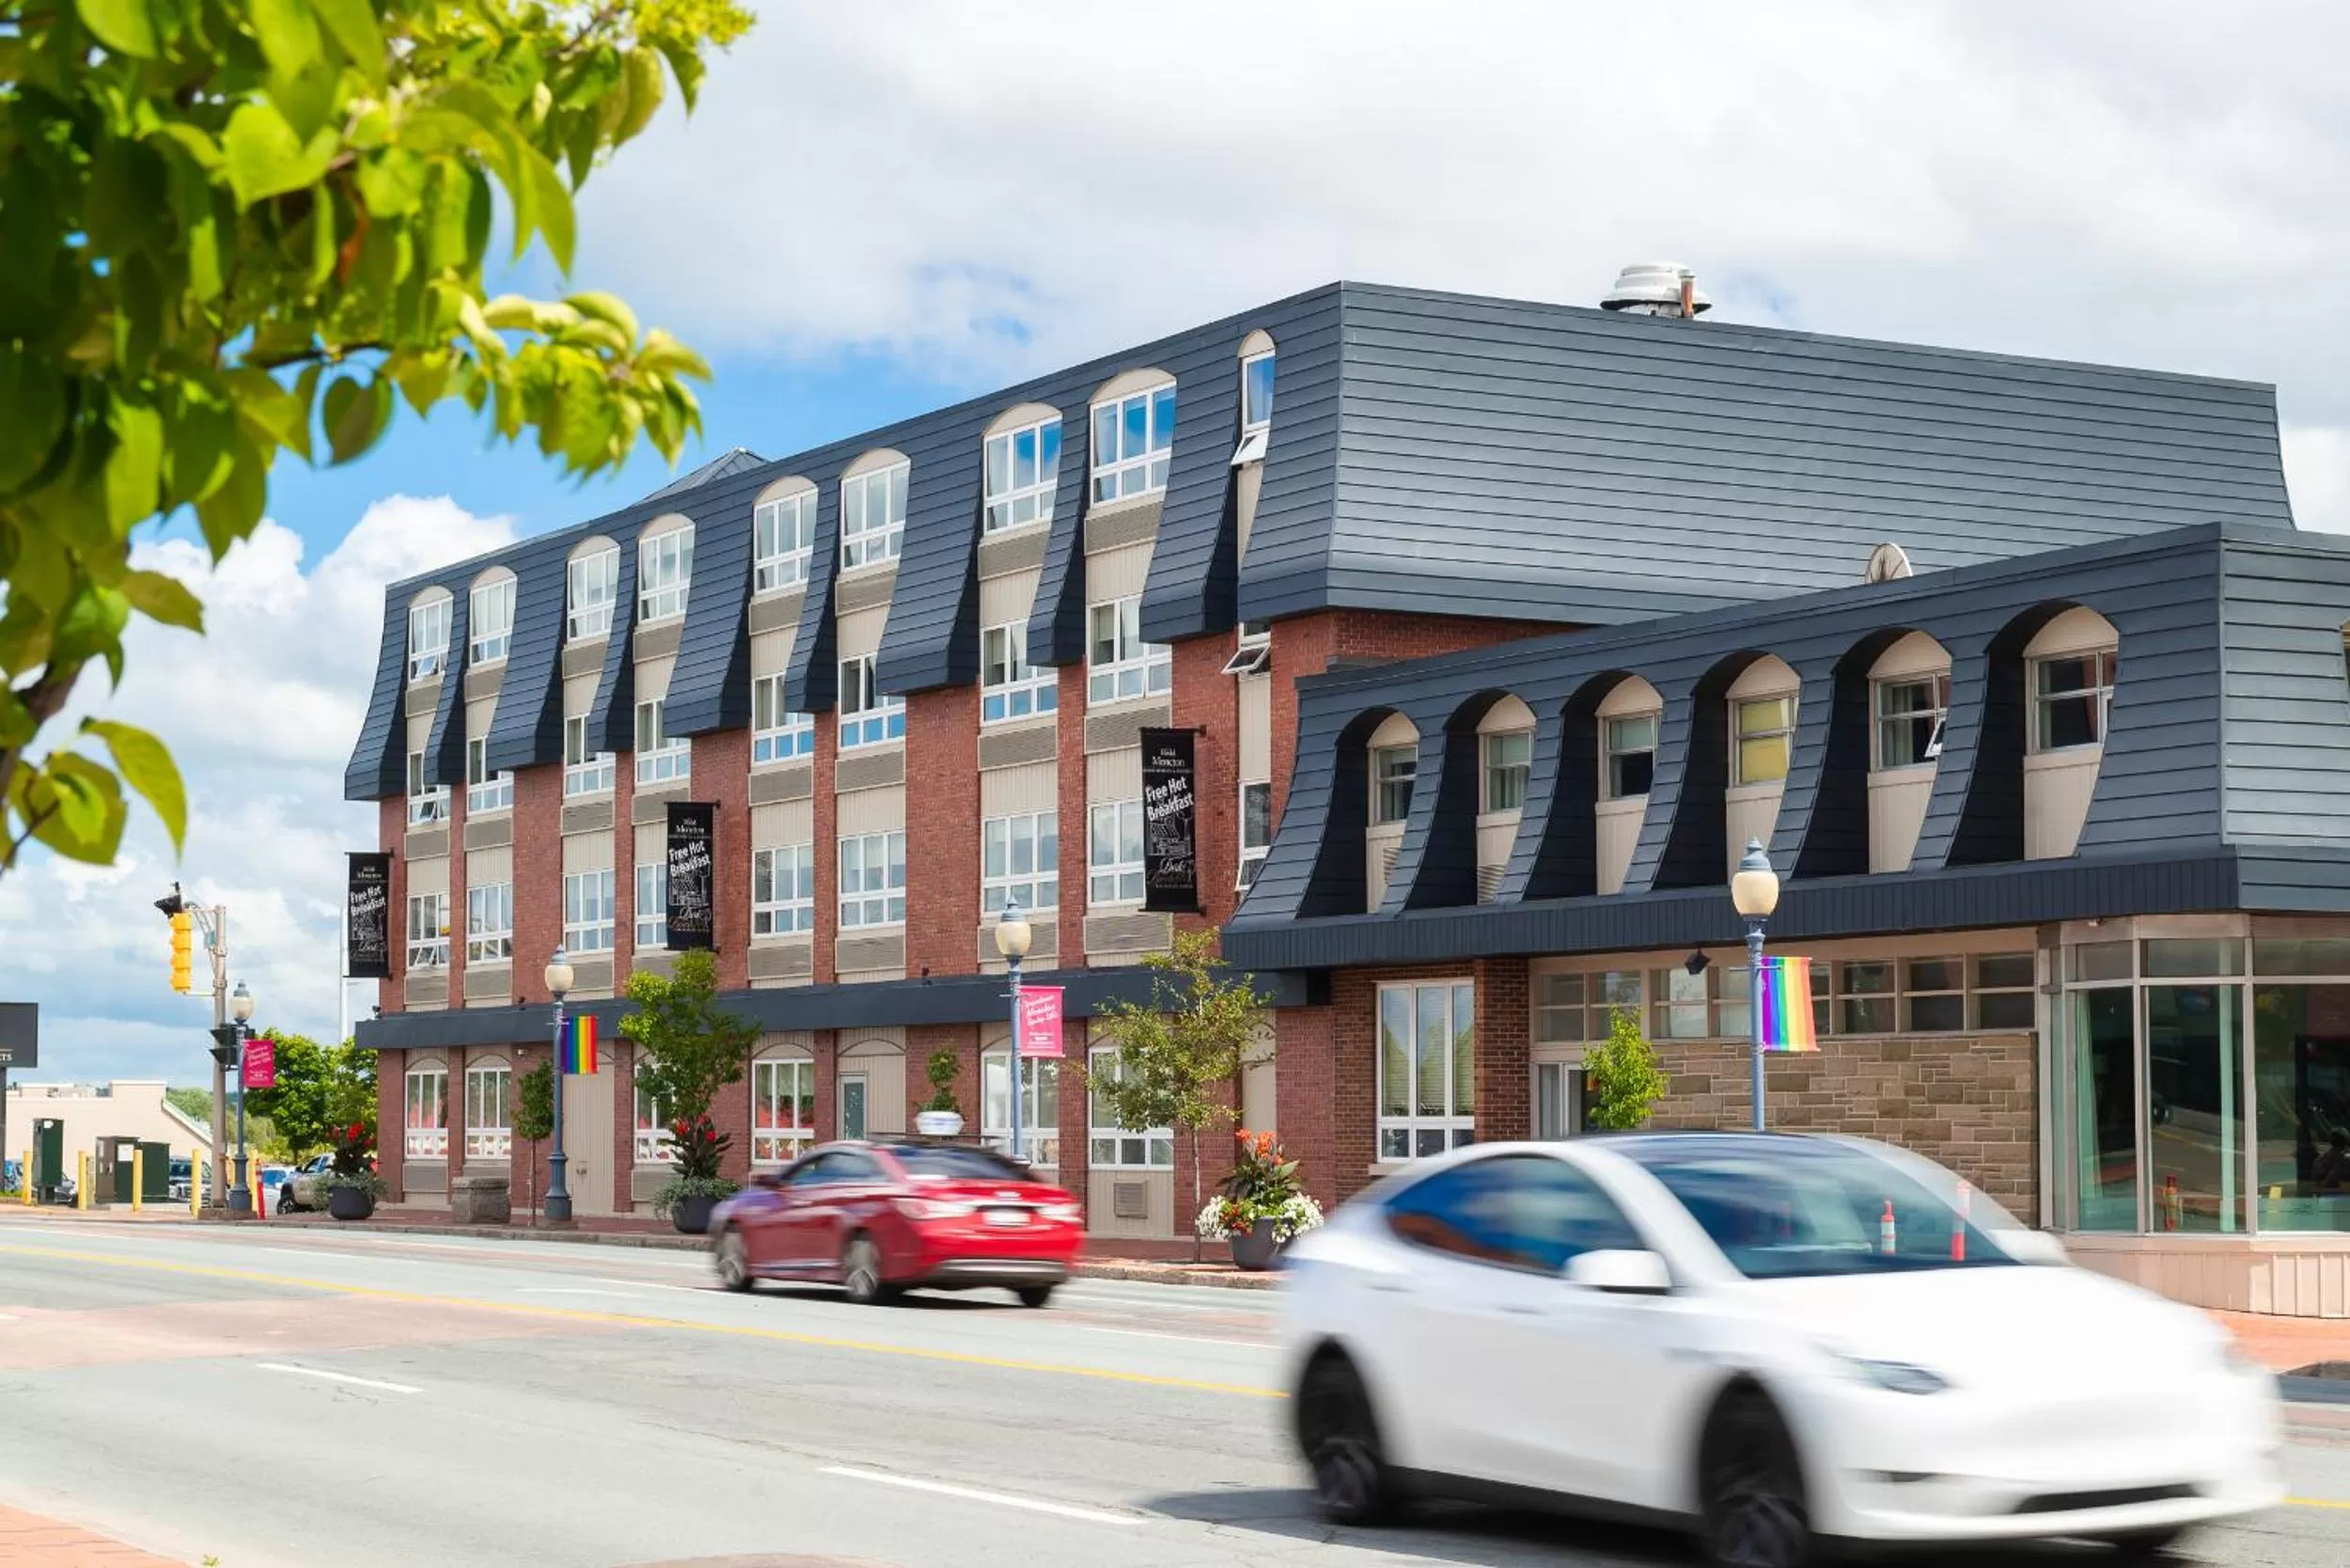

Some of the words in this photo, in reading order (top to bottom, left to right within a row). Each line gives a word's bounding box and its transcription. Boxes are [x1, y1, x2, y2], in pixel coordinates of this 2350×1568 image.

[1145, 785, 1167, 802] Free
[1167, 776, 1187, 794] Hot
[1147, 792, 1194, 821] Breakfast
[668, 847, 688, 862] Free
[689, 840, 705, 855] Hot
[670, 854, 711, 877] Breakfast
[351, 891, 367, 903] Free
[368, 886, 382, 897] Hot
[351, 897, 385, 917] Breakfast
